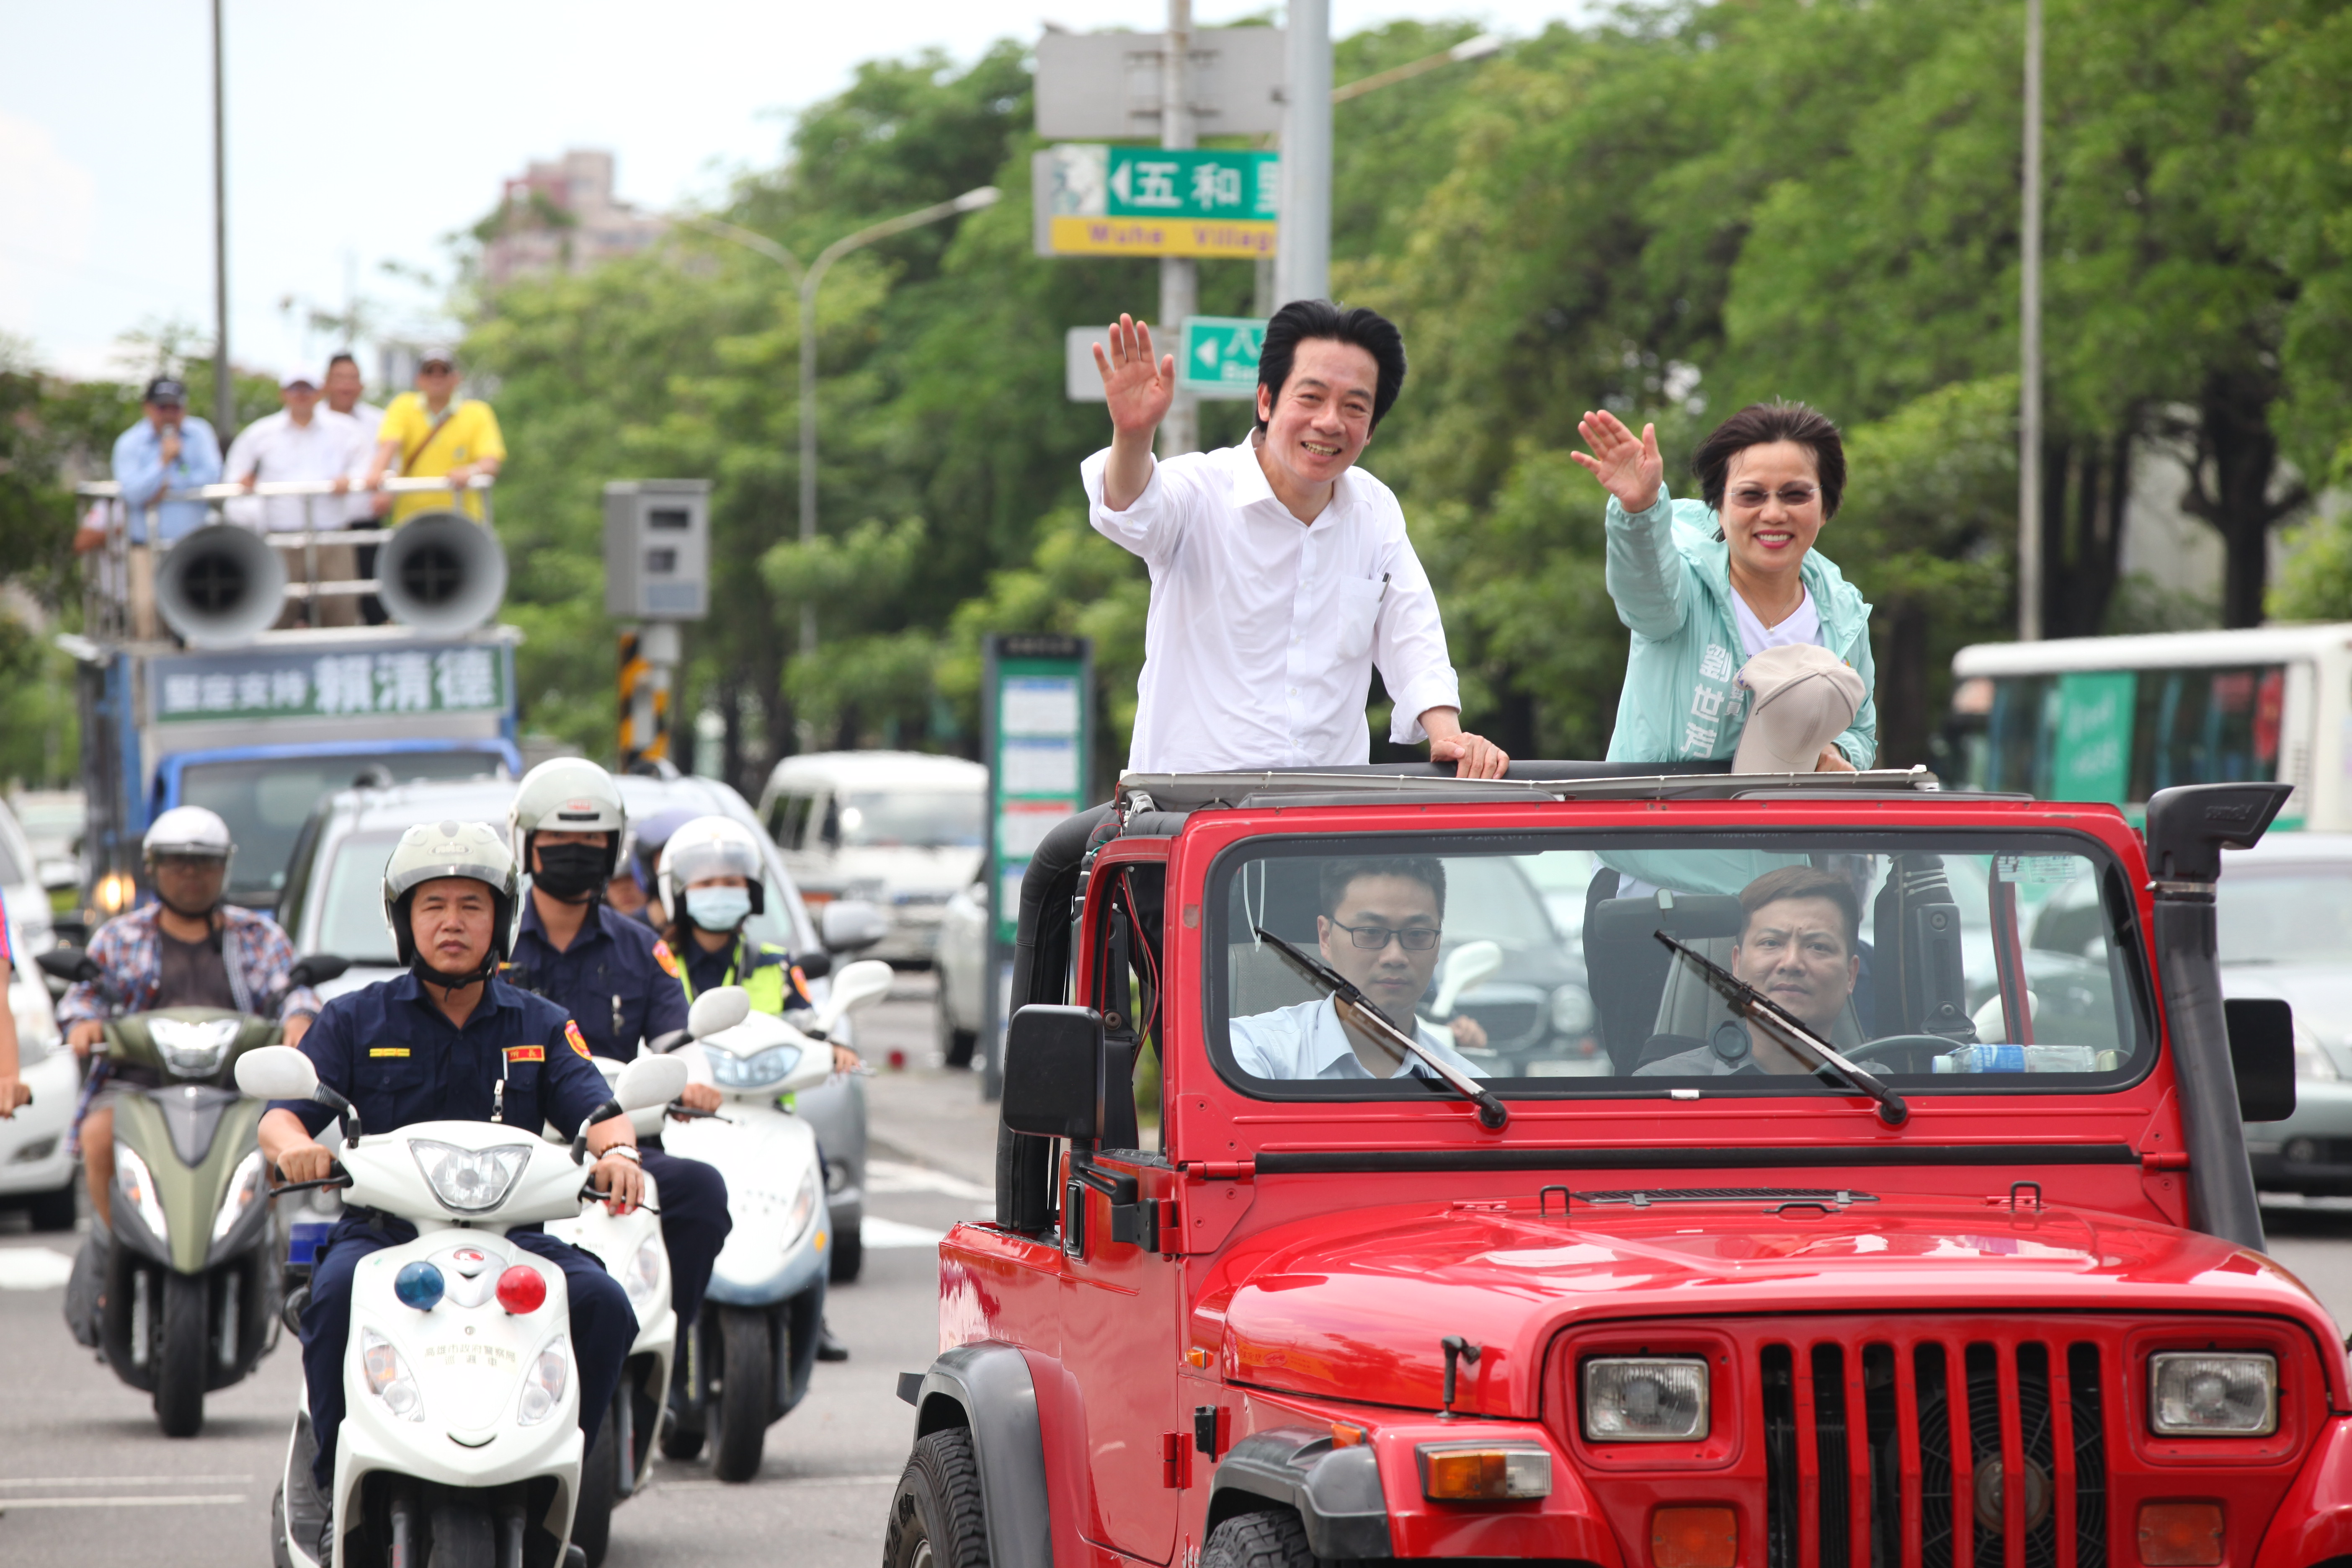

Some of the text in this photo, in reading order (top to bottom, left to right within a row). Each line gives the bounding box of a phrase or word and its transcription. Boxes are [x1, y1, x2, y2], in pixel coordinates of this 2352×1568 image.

[1088, 224, 1274, 252] Wuhe Villag
[1223, 327, 1263, 359] 八
[312, 649, 496, 714] 賴清德
[1680, 643, 1732, 758] 劉世芳
[425, 1344, 515, 1363] 高雄市政府警察局
[445, 1354, 497, 1367] 巡邏車
[1182, 1532, 1200, 1568] Jee
